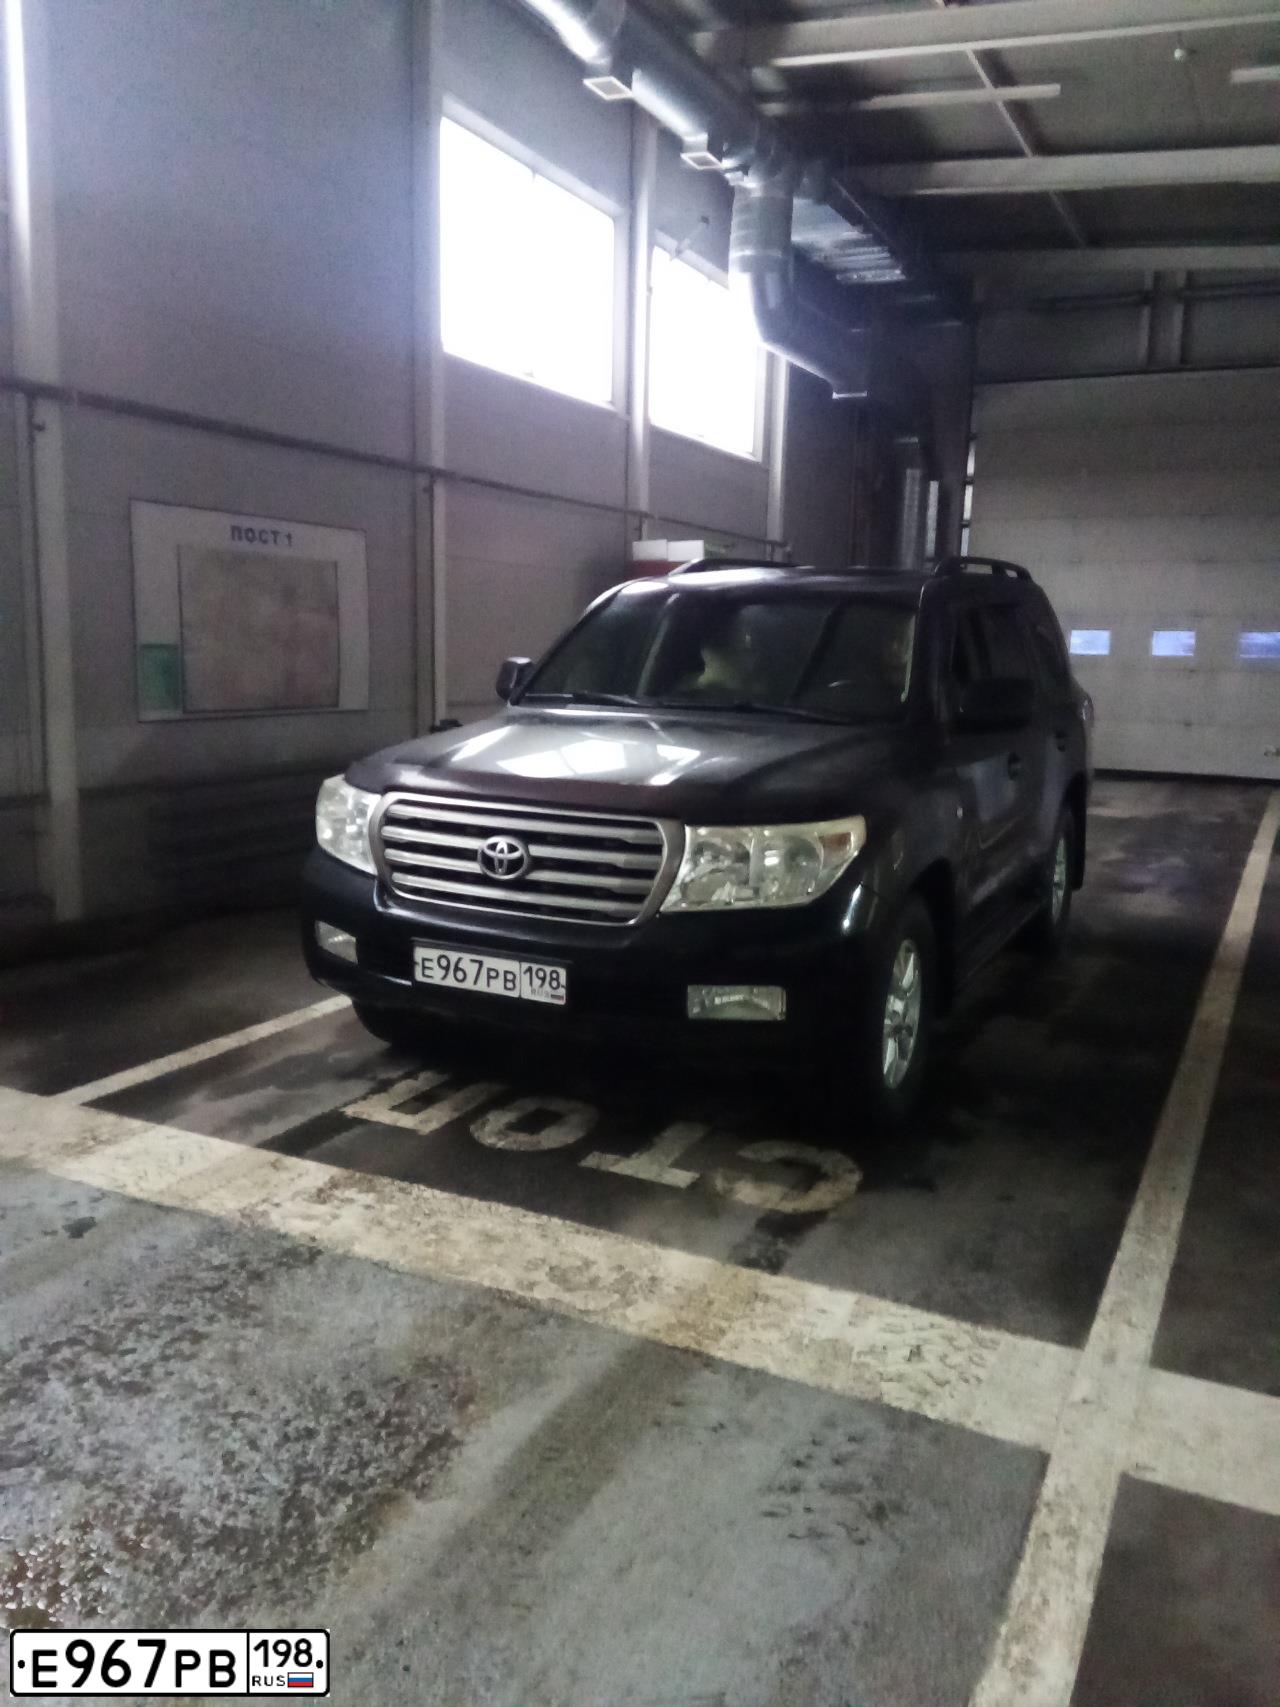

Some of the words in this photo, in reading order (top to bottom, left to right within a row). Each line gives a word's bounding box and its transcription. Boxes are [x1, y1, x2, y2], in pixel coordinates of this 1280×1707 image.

[230, 525, 281, 545] ПОСТ
[523, 965, 561, 990] 198
[342, 1070, 863, 1213] СТОП
